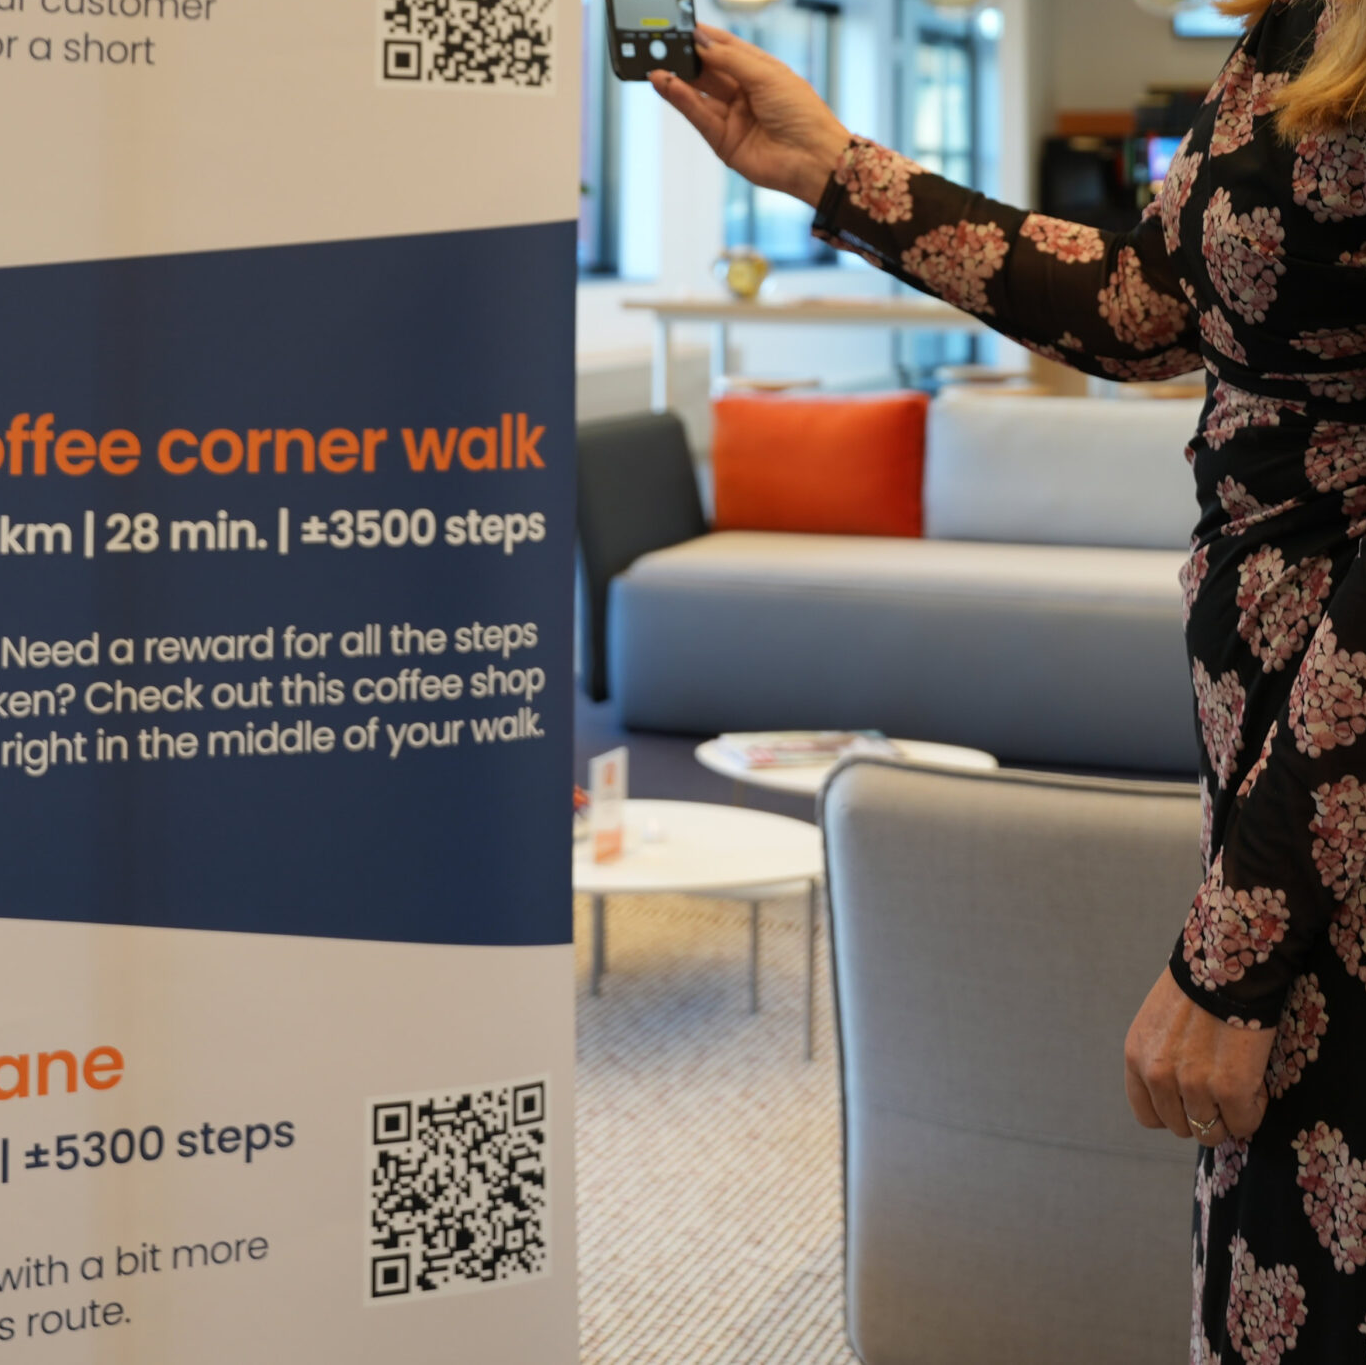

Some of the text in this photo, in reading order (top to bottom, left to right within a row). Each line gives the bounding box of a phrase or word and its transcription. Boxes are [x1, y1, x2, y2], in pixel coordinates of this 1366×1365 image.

[28, 36, 52, 61] a
[63, 31, 155, 66] short
[157, 427, 388, 475] corner
[401, 412, 546, 472] walk
[0, 514, 72, 555] km
[105, 512, 160, 553] 28
[170, 509, 268, 551] min.
[300, 508, 437, 548] ±3500
[445, 509, 546, 555] steps
[1, 621, 538, 669] Need a reward for all the steps
[84, 676, 204, 714] Check
[211, 676, 273, 709] out
[280, 671, 345, 706] this
[352, 667, 464, 704] coffee
[470, 664, 546, 702] shop
[1, 706, 545, 777] right in the middle of your walk.
[24, 1125, 165, 1171] ±5300
[177, 1120, 295, 1164] steps
[80, 1255, 104, 1281] a
[116, 1242, 162, 1277] bit
[172, 1236, 269, 1270] more
[27, 1299, 131, 1337] route.
